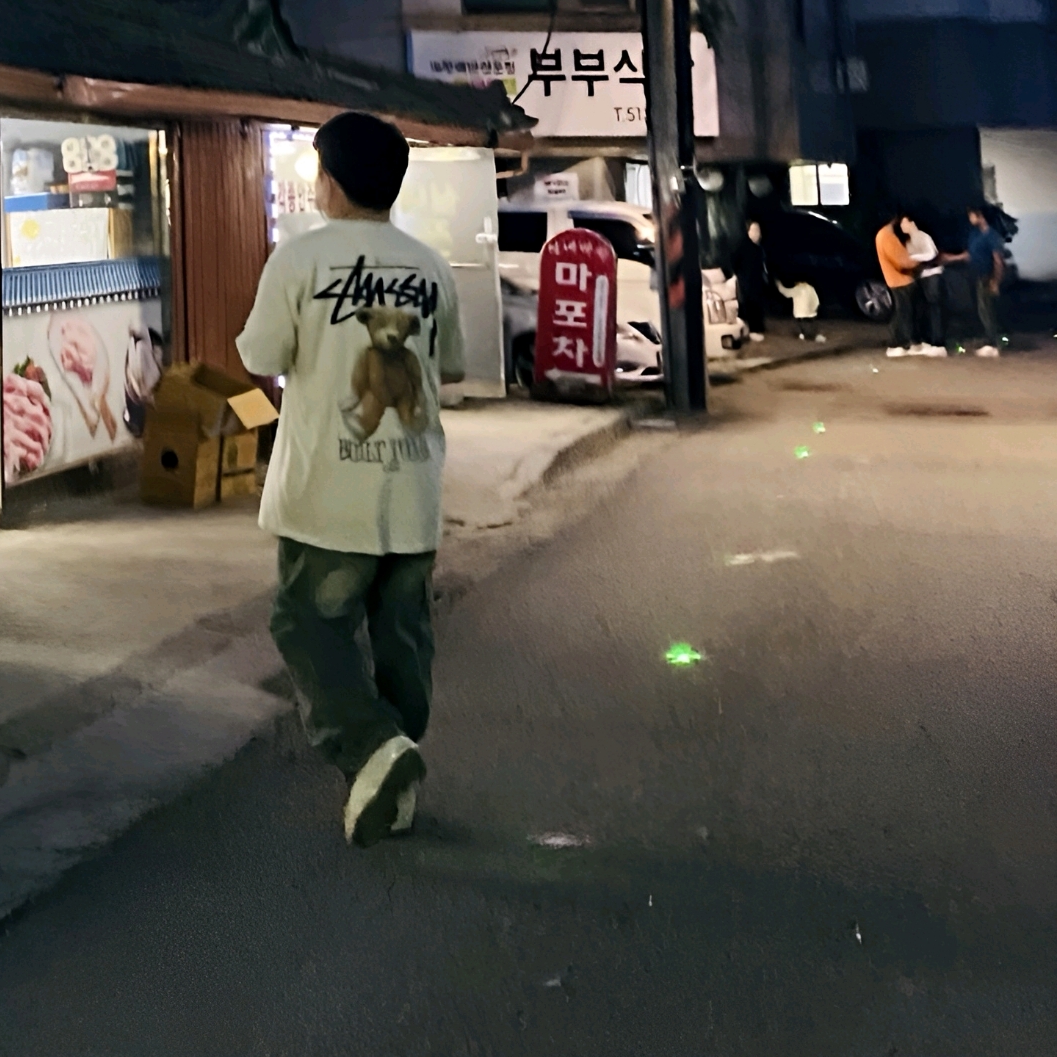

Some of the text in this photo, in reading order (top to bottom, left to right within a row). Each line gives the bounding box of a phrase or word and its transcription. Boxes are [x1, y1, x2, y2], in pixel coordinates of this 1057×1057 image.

[527, 48, 646, 97] 부부식
[613, 107, 645, 122] T.51
[552, 262, 592, 368] 마포차
